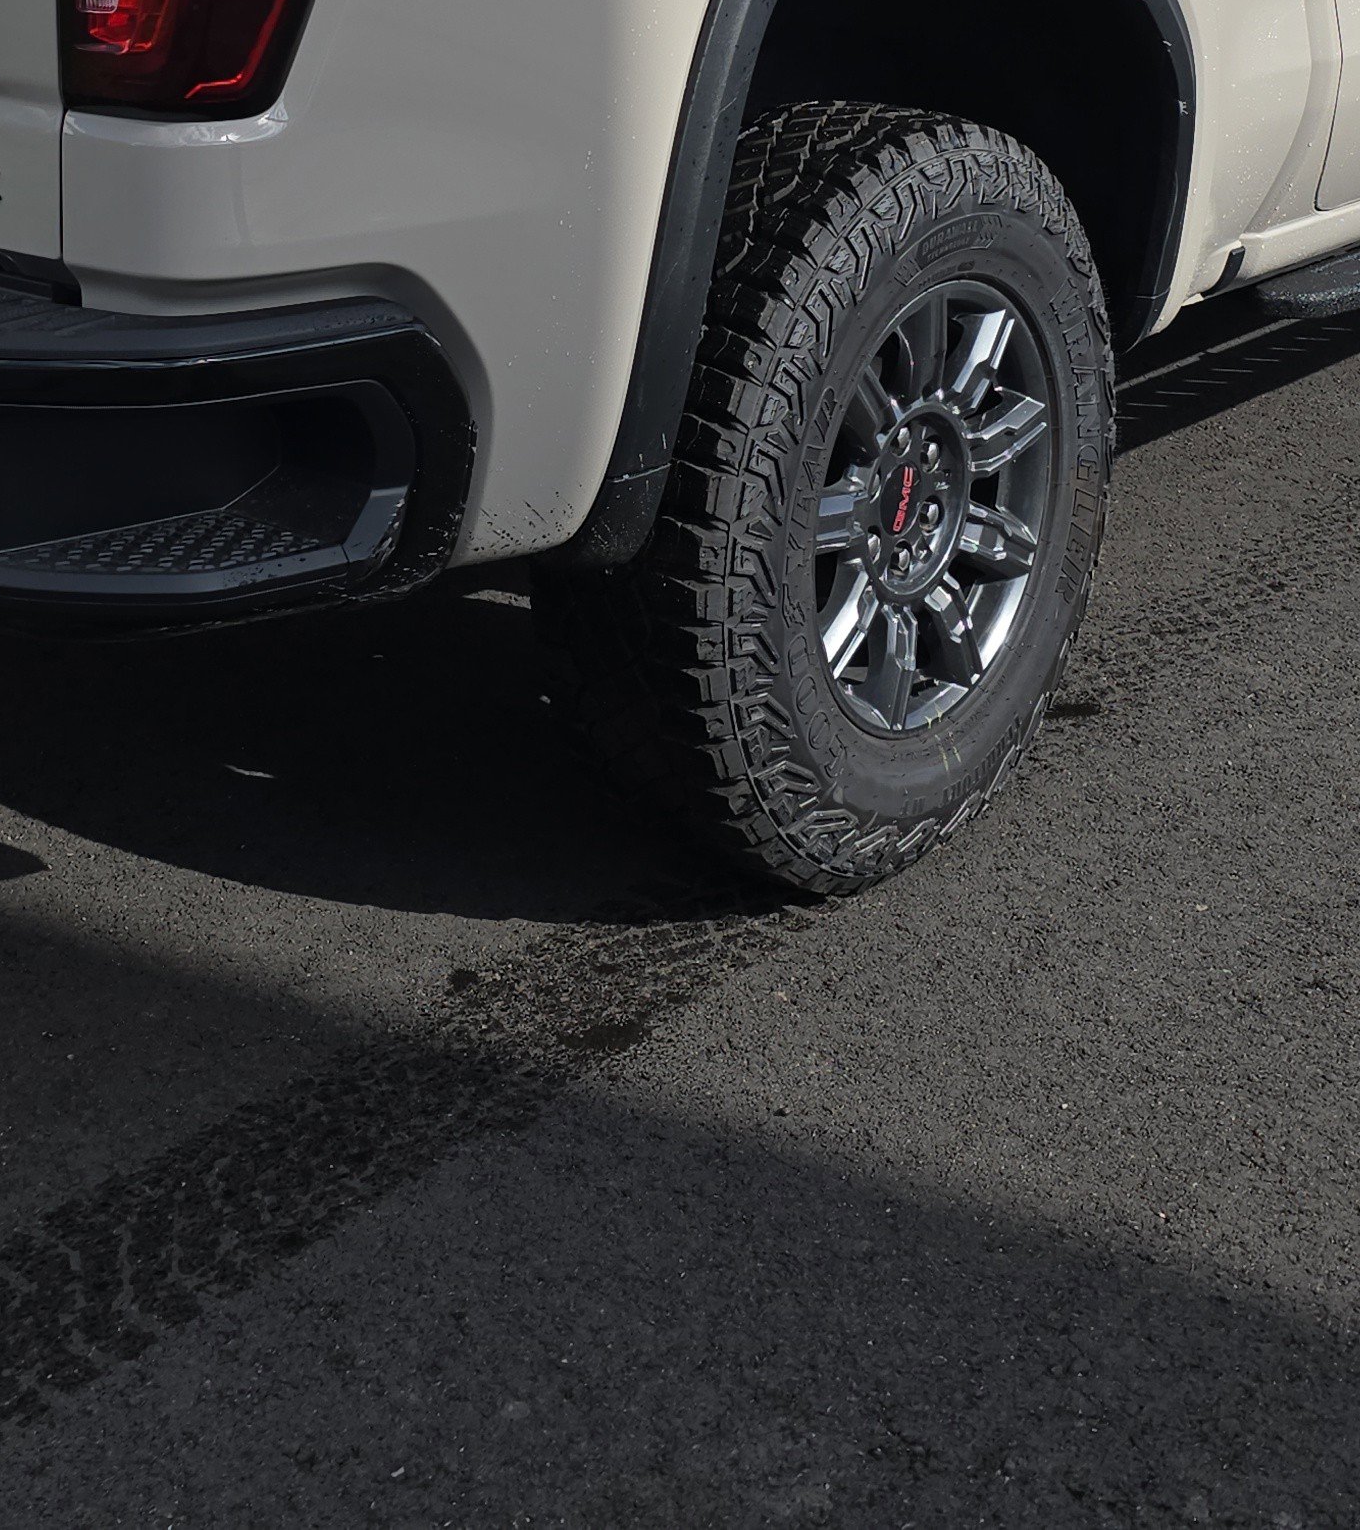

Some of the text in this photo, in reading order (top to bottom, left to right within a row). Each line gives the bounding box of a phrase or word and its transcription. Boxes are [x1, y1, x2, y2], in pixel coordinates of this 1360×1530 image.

[782, 386, 847, 786] GOODYEAR
[892, 465, 915, 532] GMC
[1049, 276, 1101, 604] WRANGLER
